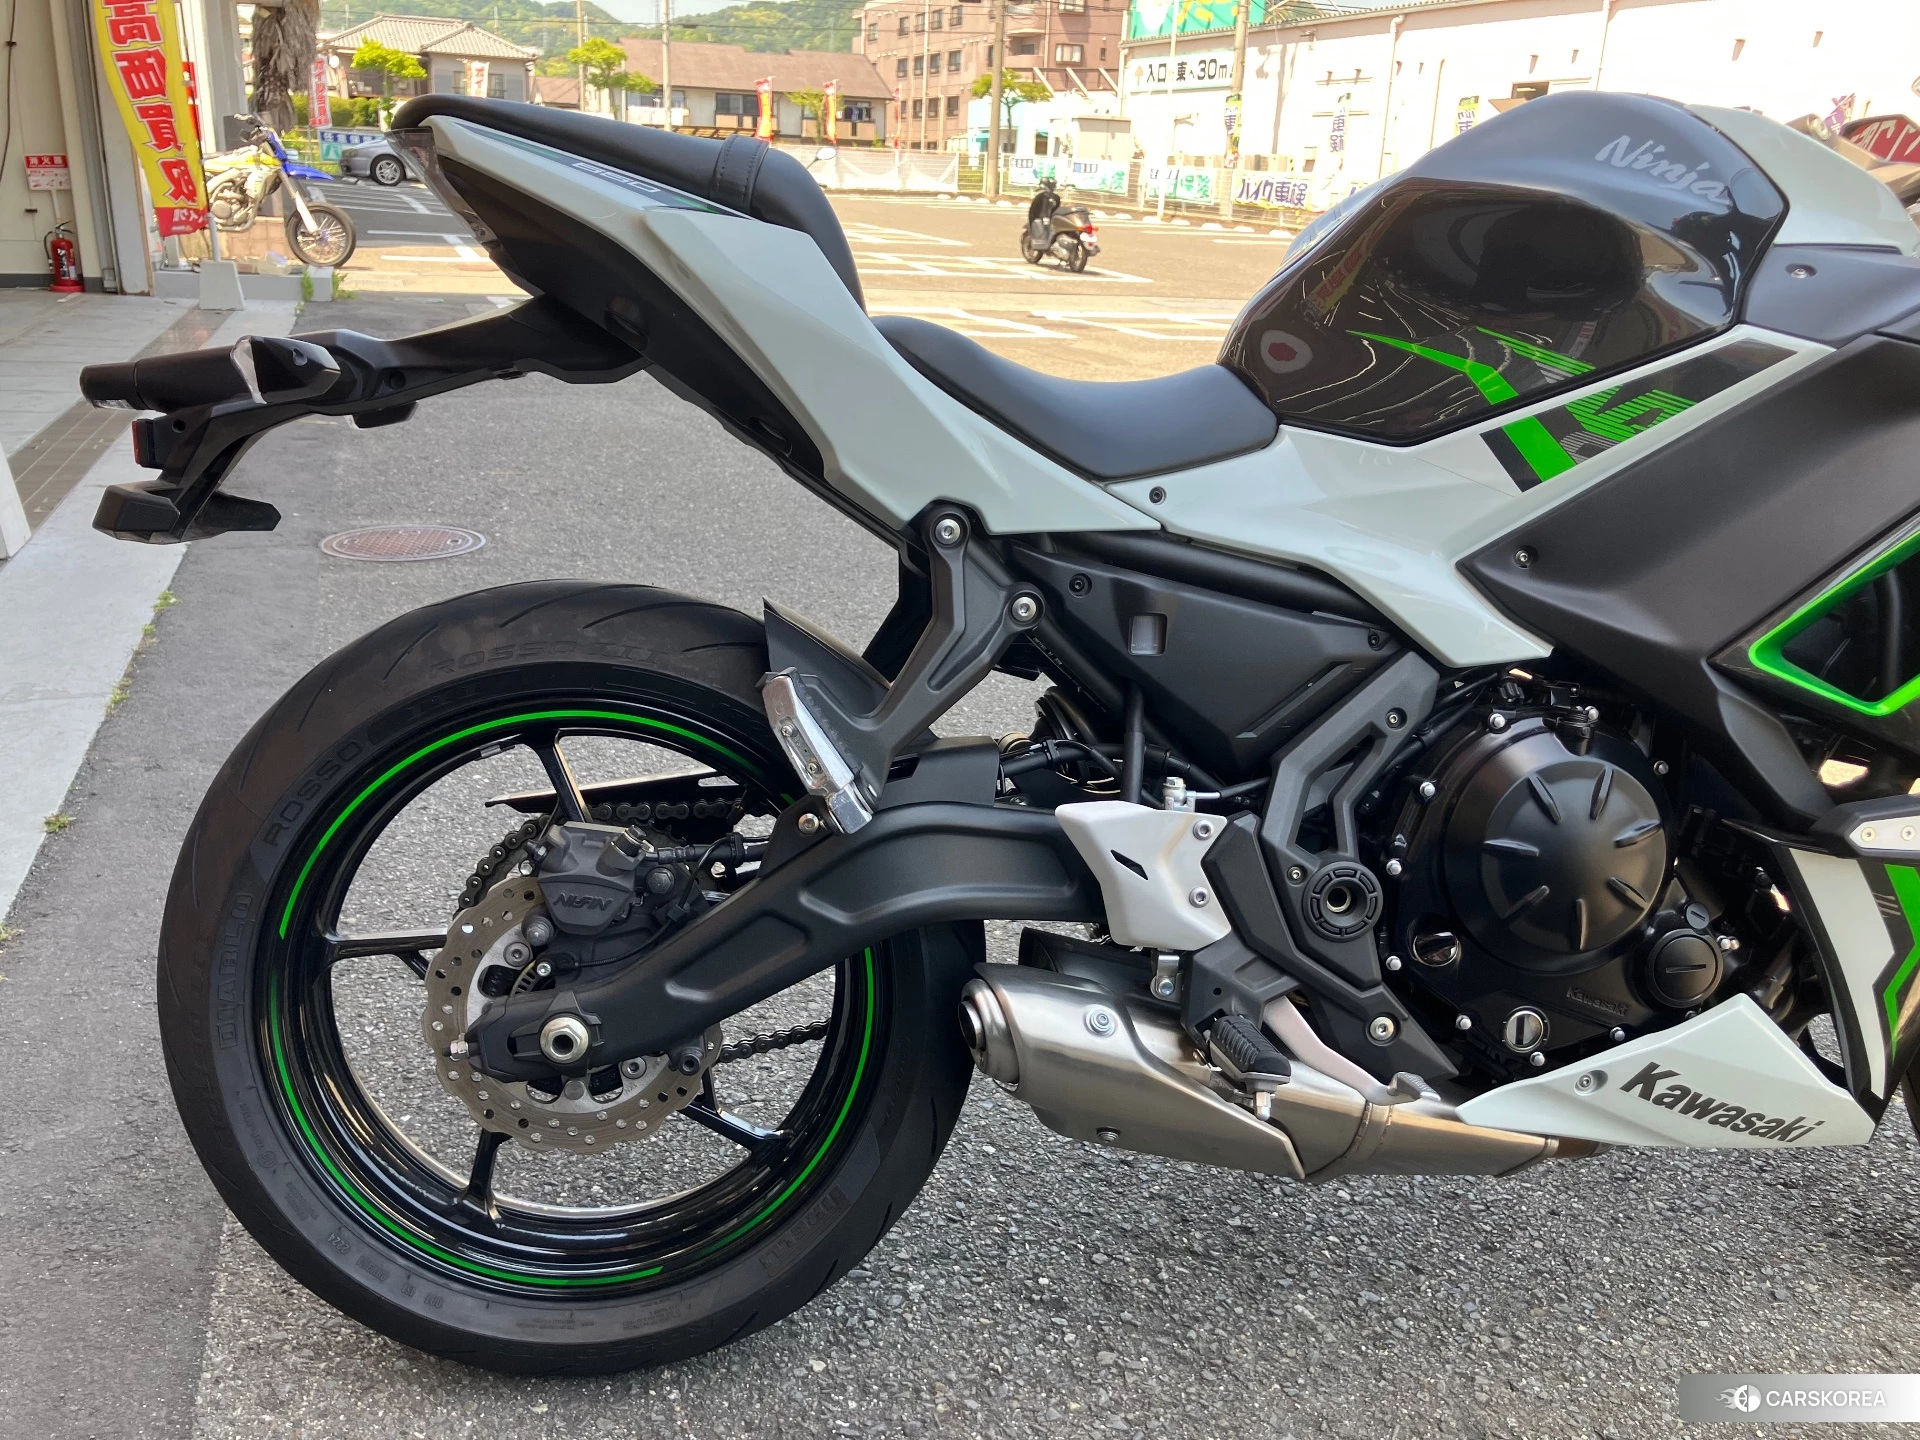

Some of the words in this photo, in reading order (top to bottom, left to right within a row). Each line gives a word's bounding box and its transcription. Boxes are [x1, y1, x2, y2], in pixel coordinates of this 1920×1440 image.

[571, 162, 661, 193] 650
[1238, 178, 1308, 206] バイク車検
[1594, 134, 1733, 207] Ninja
[429, 640, 577, 677] ROSSO
[263, 739, 362, 847] ROSSO
[216, 893, 253, 1049] DIABLO
[1566, 985, 1629, 1016] Kawasaki
[1619, 1061, 1825, 1143] Kawasaki
